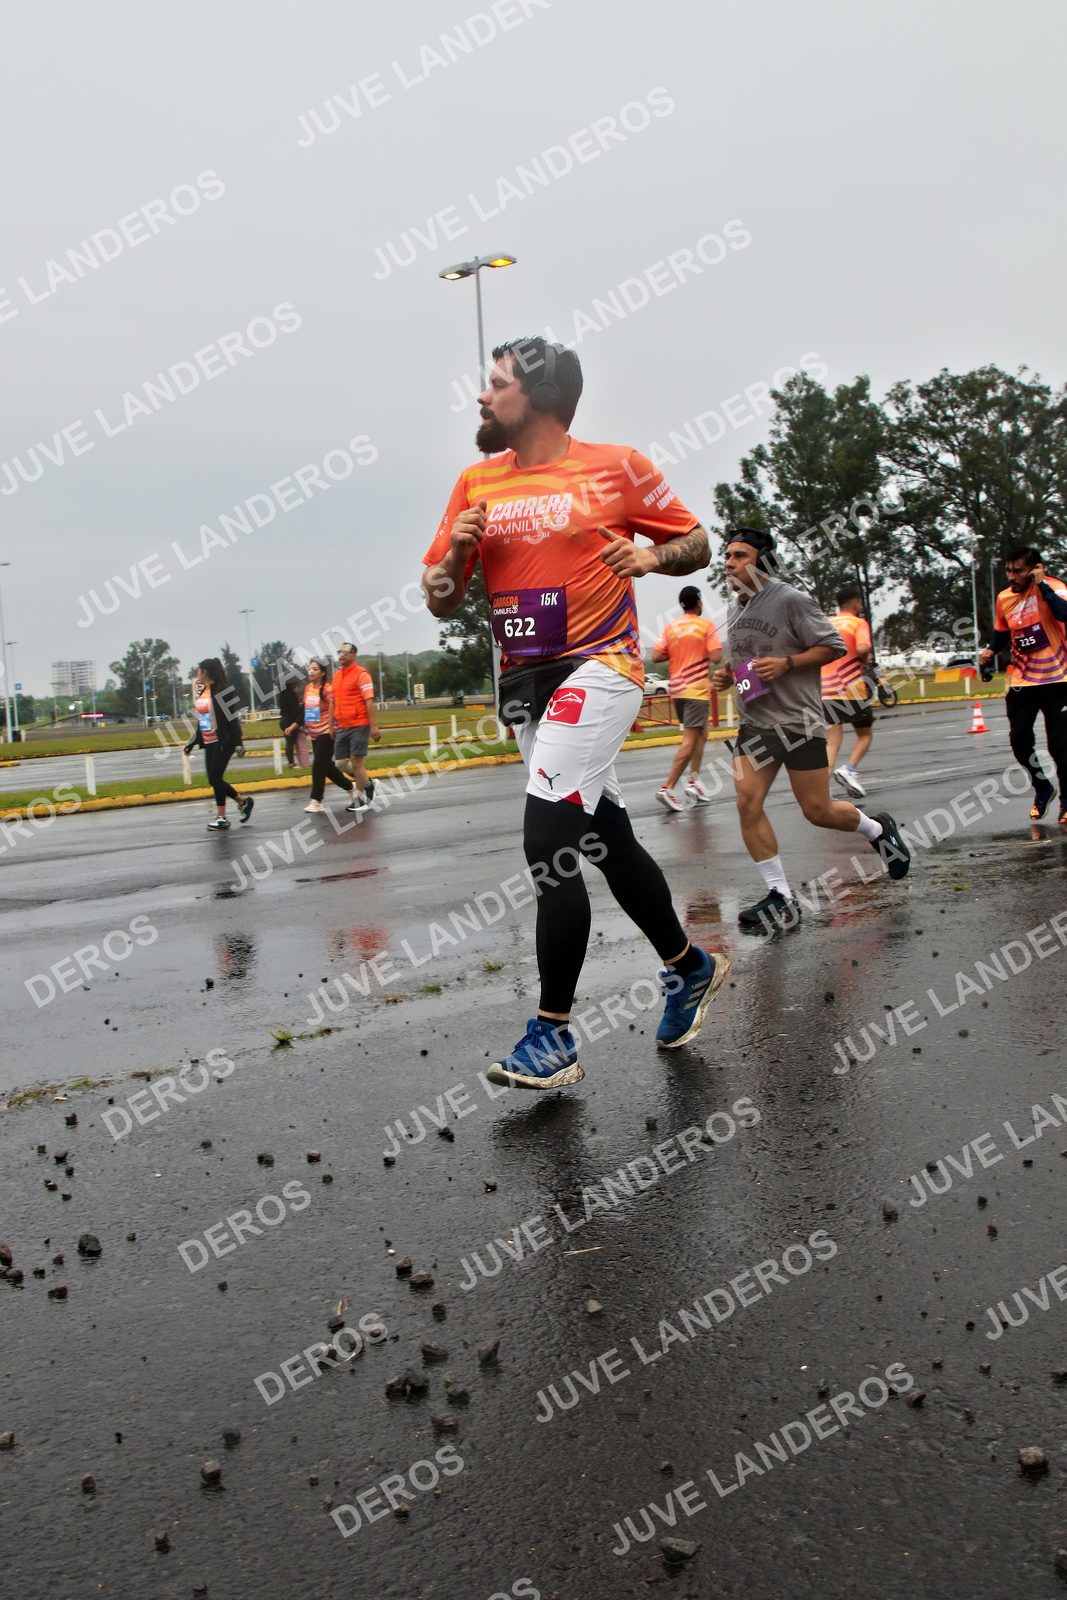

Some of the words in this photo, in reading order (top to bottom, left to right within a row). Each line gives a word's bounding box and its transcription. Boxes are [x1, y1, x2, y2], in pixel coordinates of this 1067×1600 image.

[488, 493, 573, 521] CARRERA
[485, 514, 551, 537] OMNILIFE
[540, 592, 559, 606] 15K
[493, 607, 512, 616] OMNILIFE
[504, 617, 536, 638] 622
[1019, 636, 1036, 647] 225
